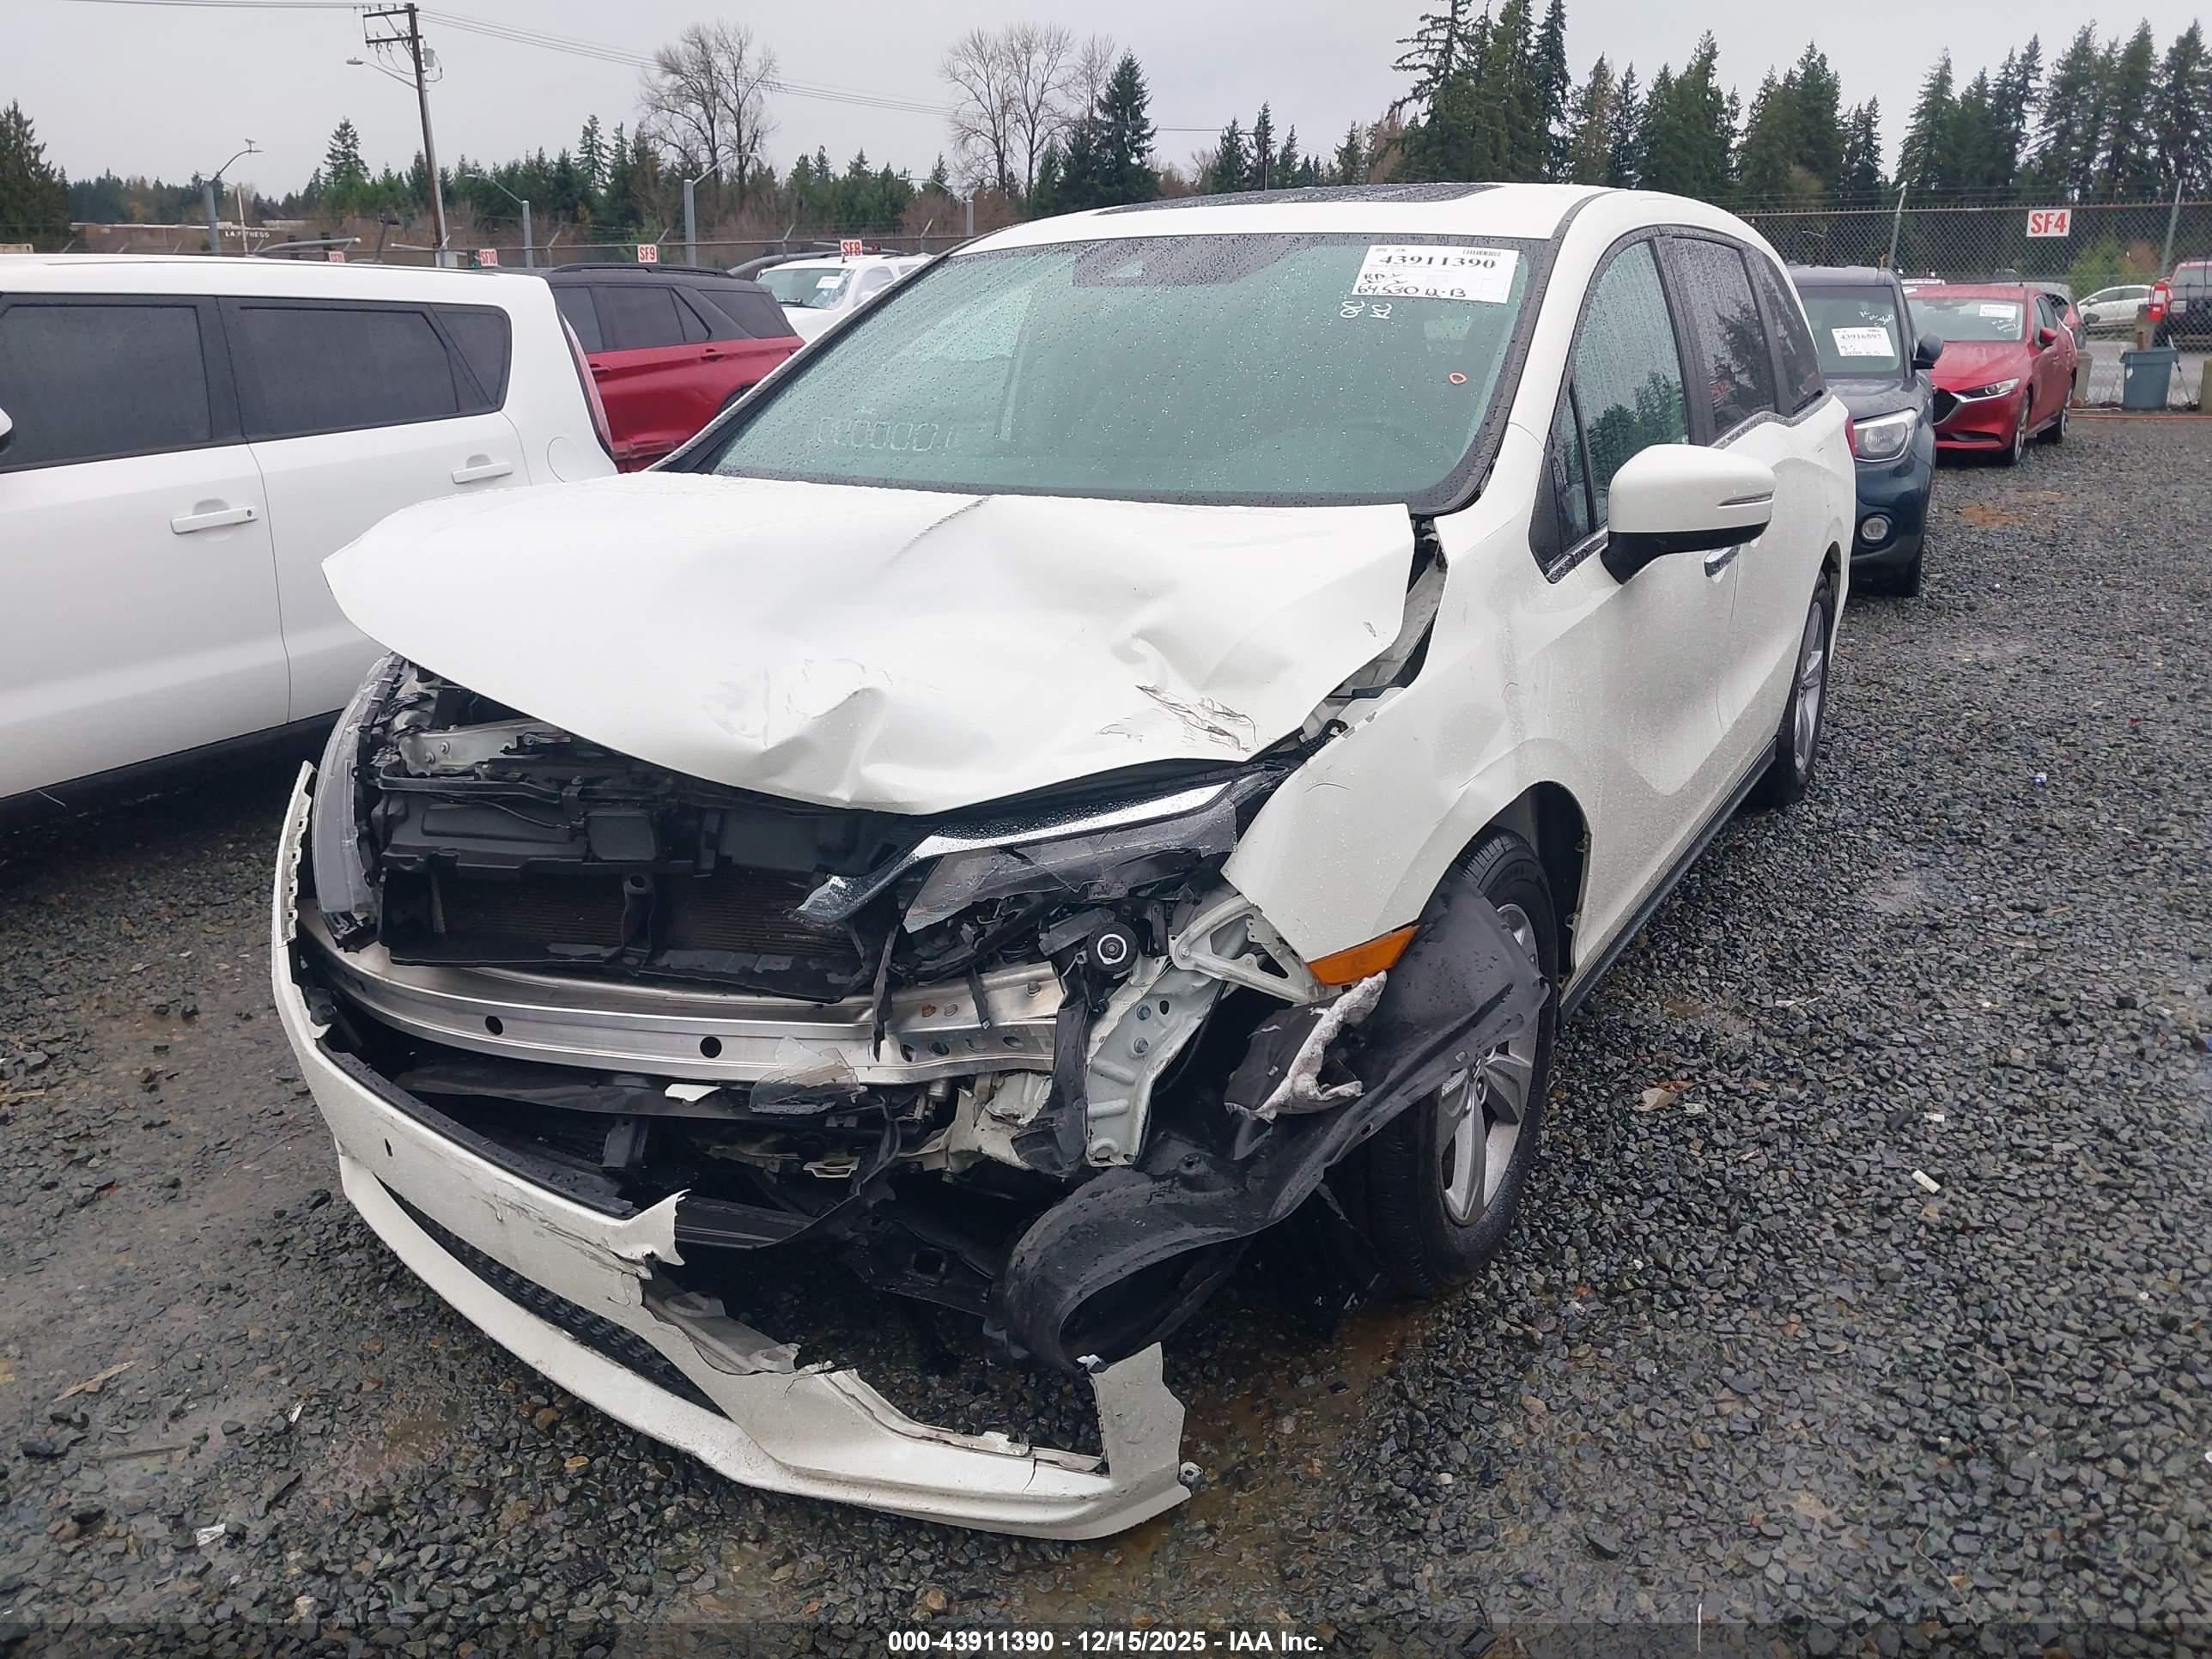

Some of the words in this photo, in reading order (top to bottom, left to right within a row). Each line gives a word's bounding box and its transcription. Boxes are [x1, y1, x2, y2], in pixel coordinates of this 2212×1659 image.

[2030, 212, 2067, 234] SF4
[639, 246, 655, 261] SF9
[842, 241, 861, 261] SF8
[1379, 254, 1497, 269] 43911390
